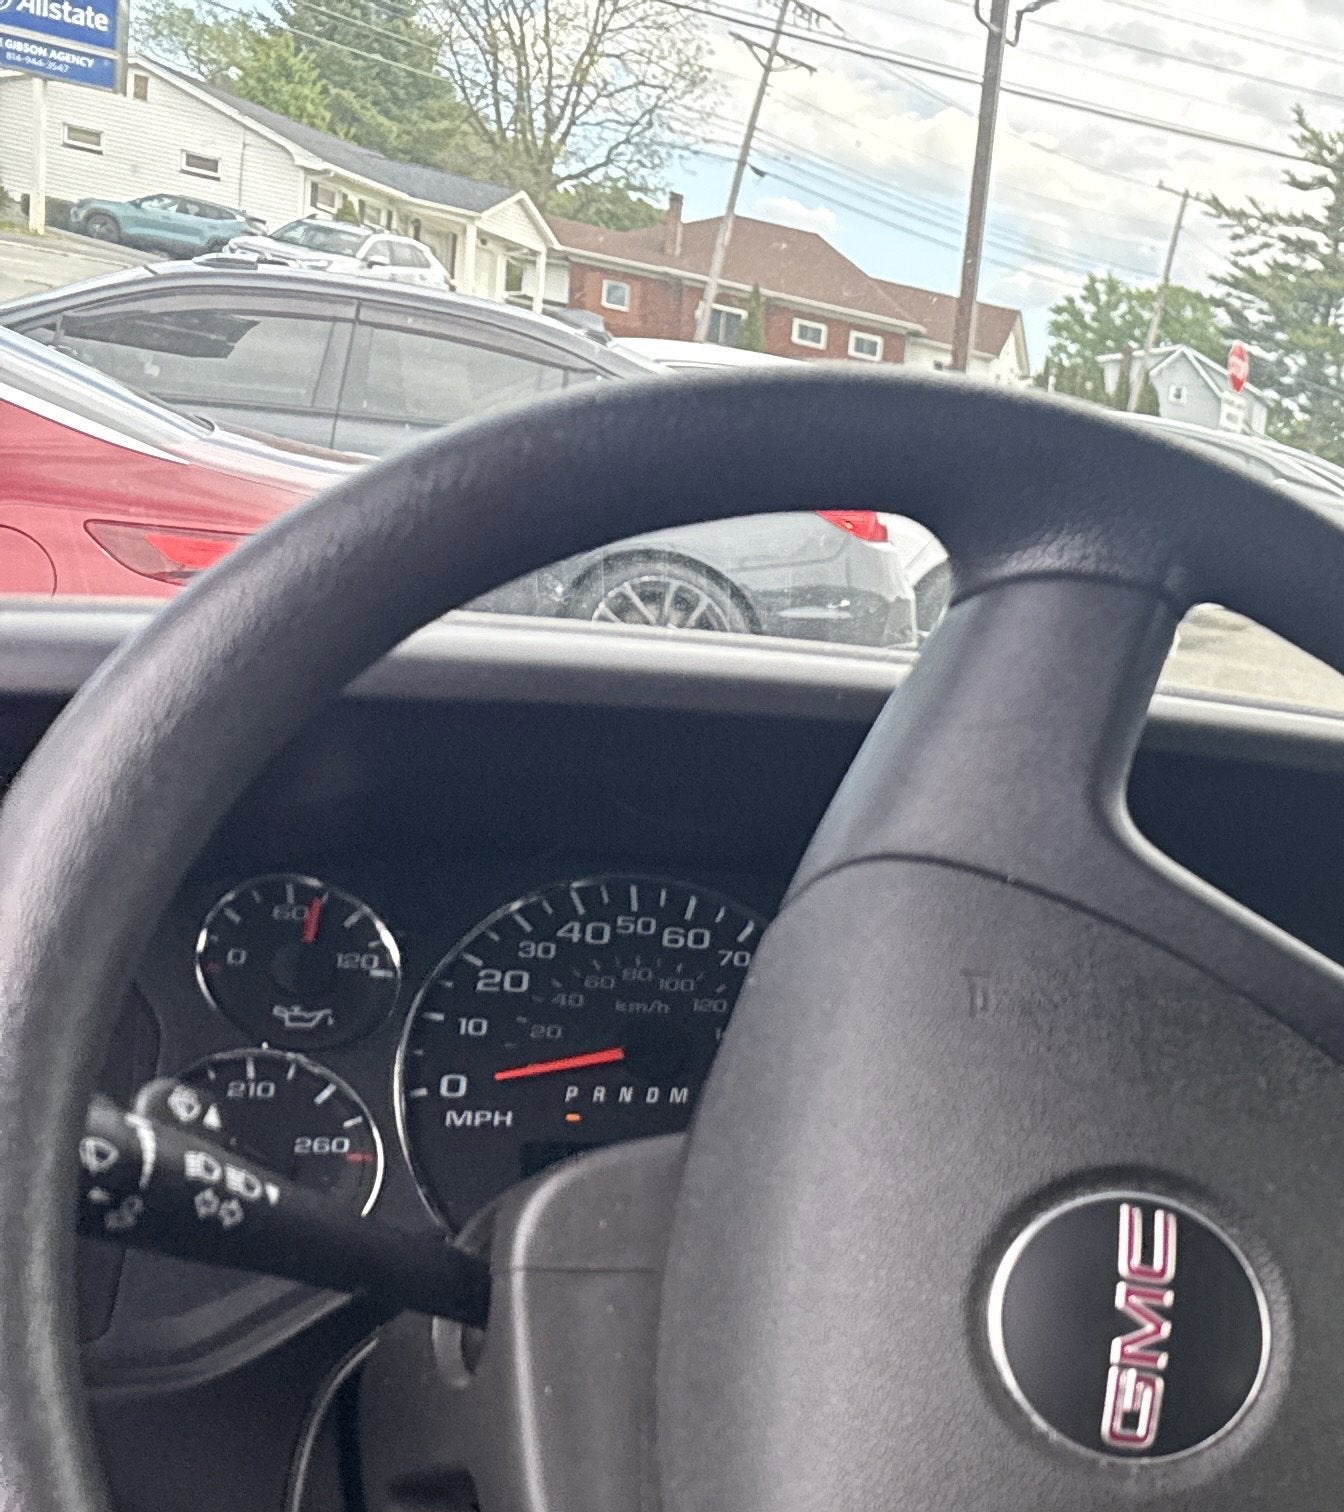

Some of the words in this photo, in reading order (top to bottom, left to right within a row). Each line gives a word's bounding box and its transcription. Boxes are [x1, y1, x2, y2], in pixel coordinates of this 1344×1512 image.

[16, 0, 109, 31] Allstate
[5, 39, 48, 56] GIBSON
[49, 49, 95, 68] AGENCY
[557, 921, 611, 945] 40
[617, 916, 656, 935] 50
[662, 927, 710, 949] 60
[518, 941, 556, 959] 30
[718, 950, 750, 967] 70
[336, 952, 379, 969] 120
[476, 969, 529, 993] 20
[615, 1000, 670, 1014] km/h
[458, 1017, 488, 1036] 10
[226, 1080, 276, 1098] 210
[440, 1074, 467, 1098] 0
[445, 1110, 513, 1127] MPH
[294, 1136, 350, 1154] 260
[1100, 1203, 1177, 1450] GMC
